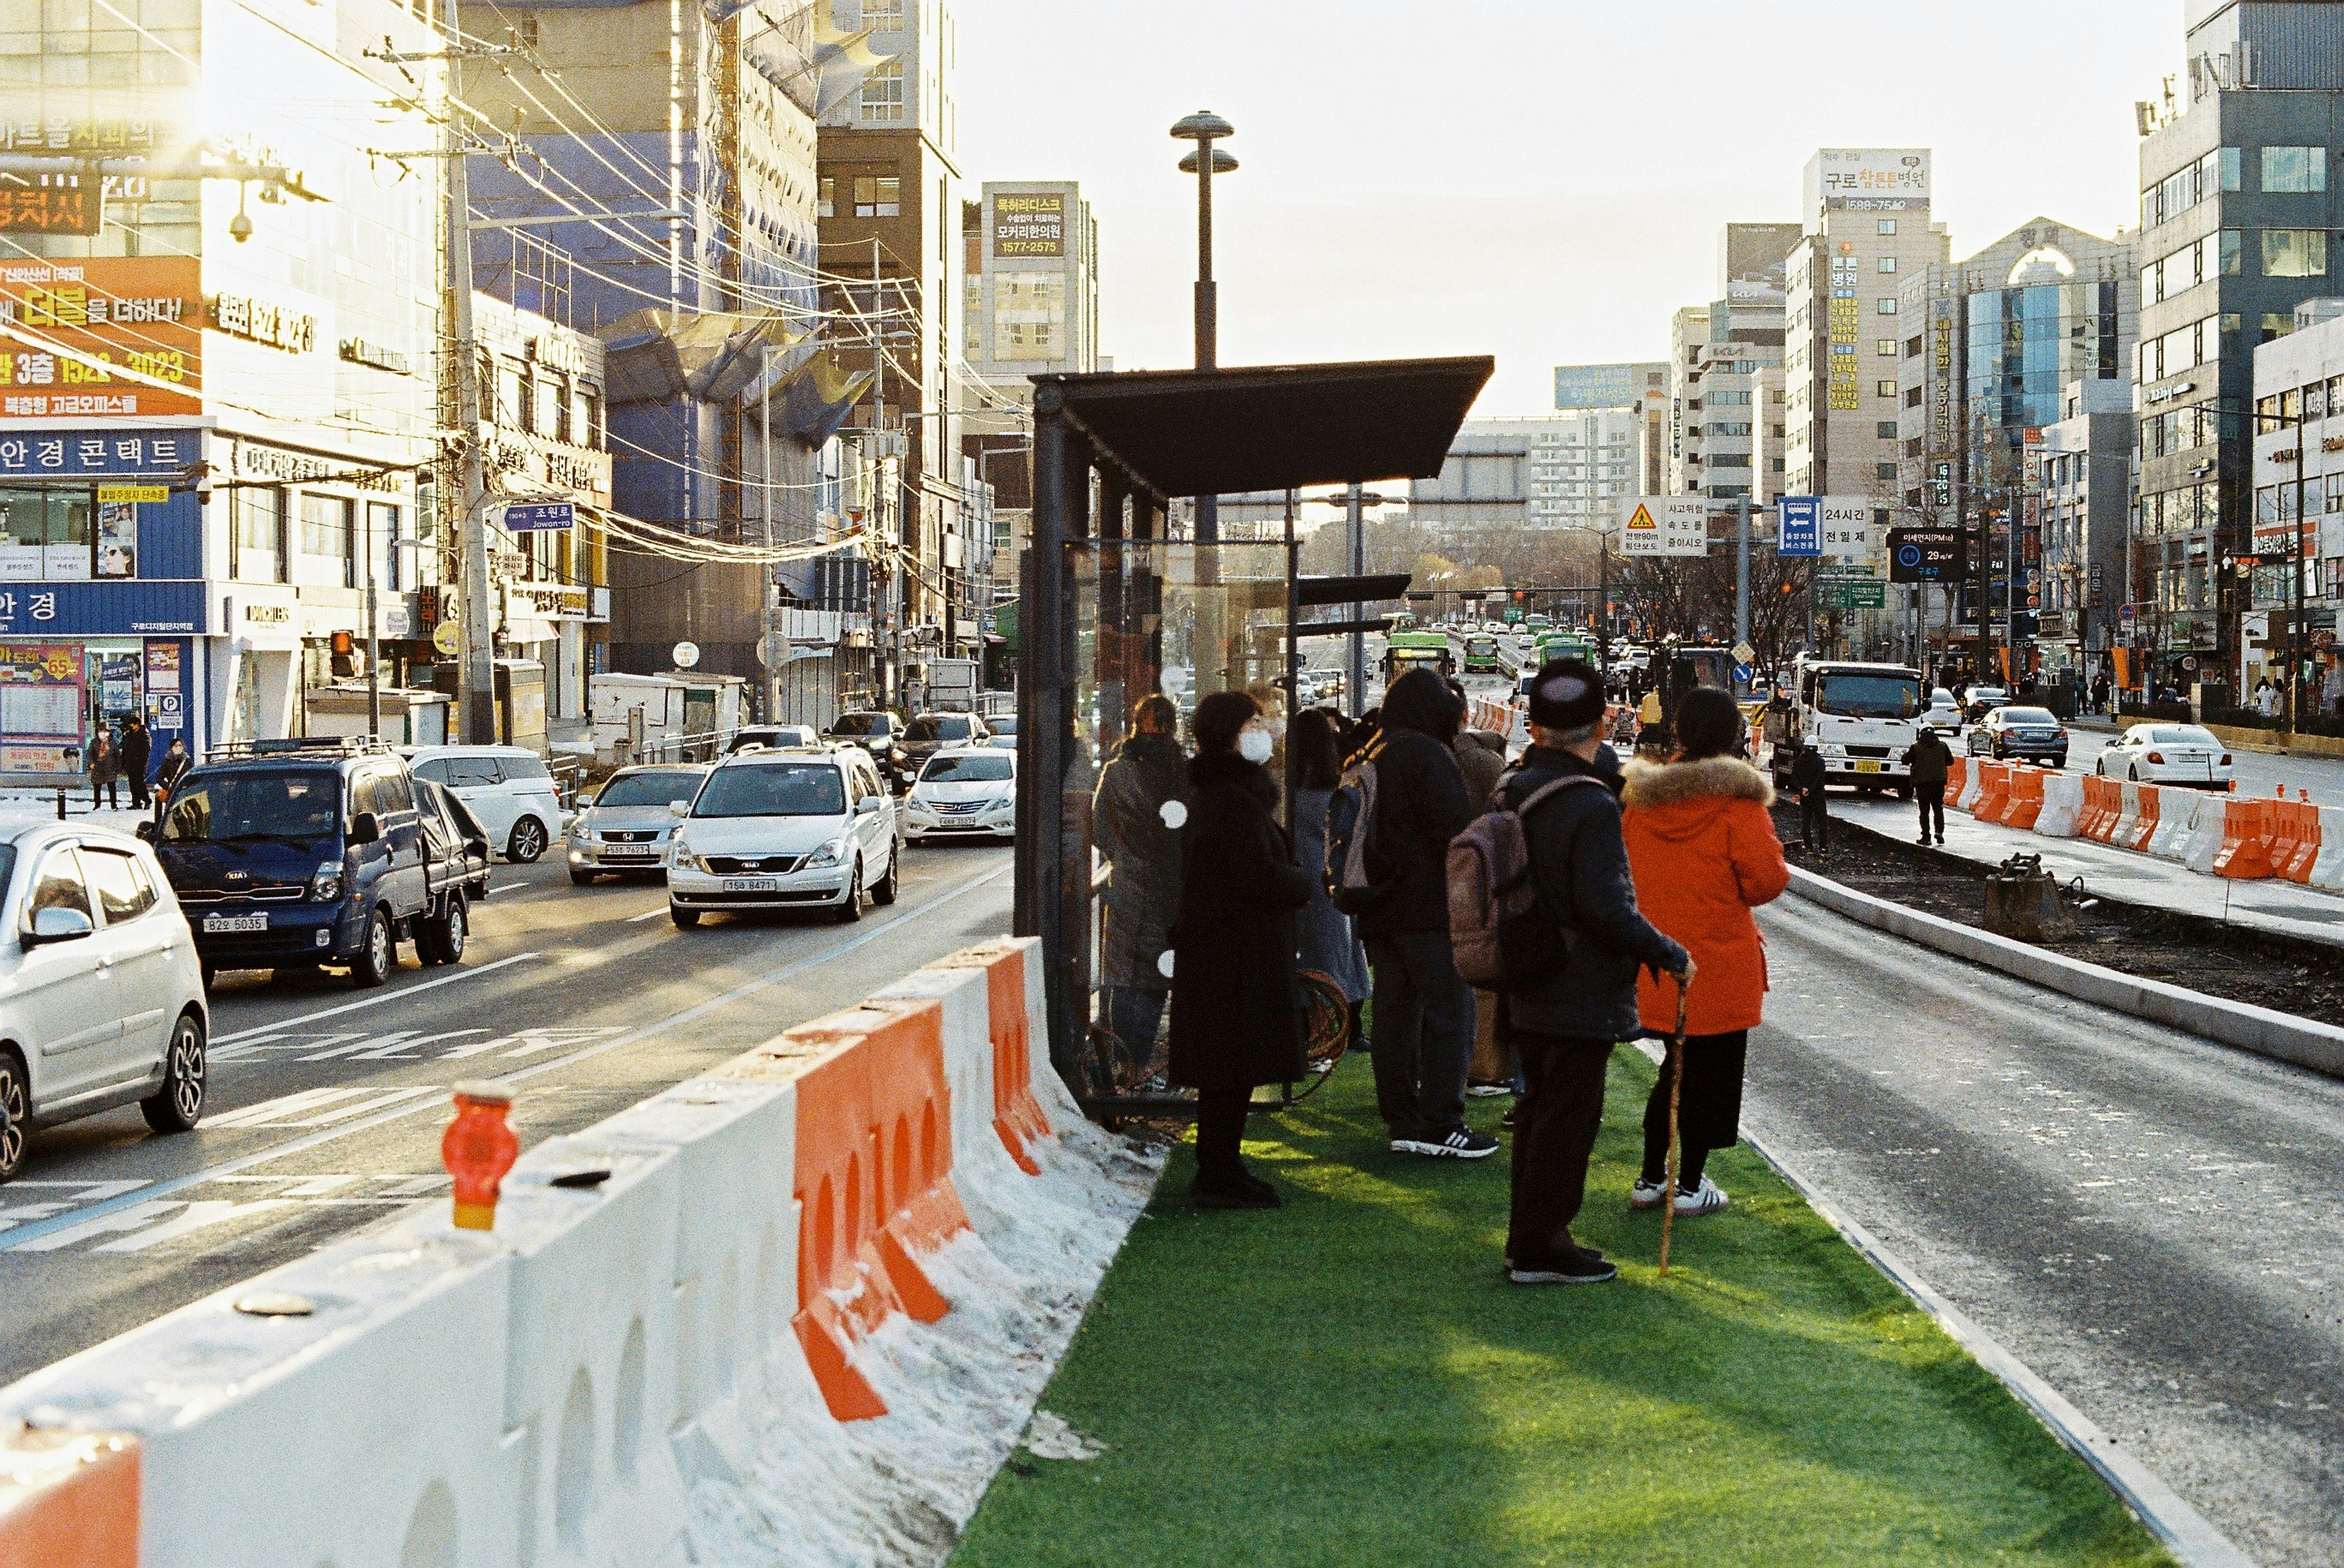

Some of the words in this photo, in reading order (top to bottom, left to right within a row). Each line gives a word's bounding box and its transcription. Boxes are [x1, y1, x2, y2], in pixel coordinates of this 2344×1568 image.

[998, 199, 1061, 212] 목허리디스크
[998, 225, 1061, 238] 모커리한의원
[1003, 242, 1056, 253] 1577-2575
[1832, 272, 1857, 286] 병원
[113, 297, 183, 323] 더하다!
[16, 353, 54, 384] 3층
[5, 396, 47, 415] 복층형
[51, 395, 137, 414] 고급오피스텔
[1939, 465, 1948, 476] 16
[2027, 450, 2037, 482] 다이소
[100, 490, 139, 500] 불법주정차
[141, 490, 165, 500] 단속중
[536, 506, 570, 518] 조원로
[1669, 504, 1703, 514] 사고위험
[1825, 509, 1865, 520] 24시간
[1668, 538, 1702, 548] 줄이시오
[1927, 551, 1939, 560] 29
[131, 622, 194, 631] 구로디지털단지역점
[48, 659, 69, 674] 65
[748, 881, 770, 889] 8471
[236, 918, 261, 930] 5035
